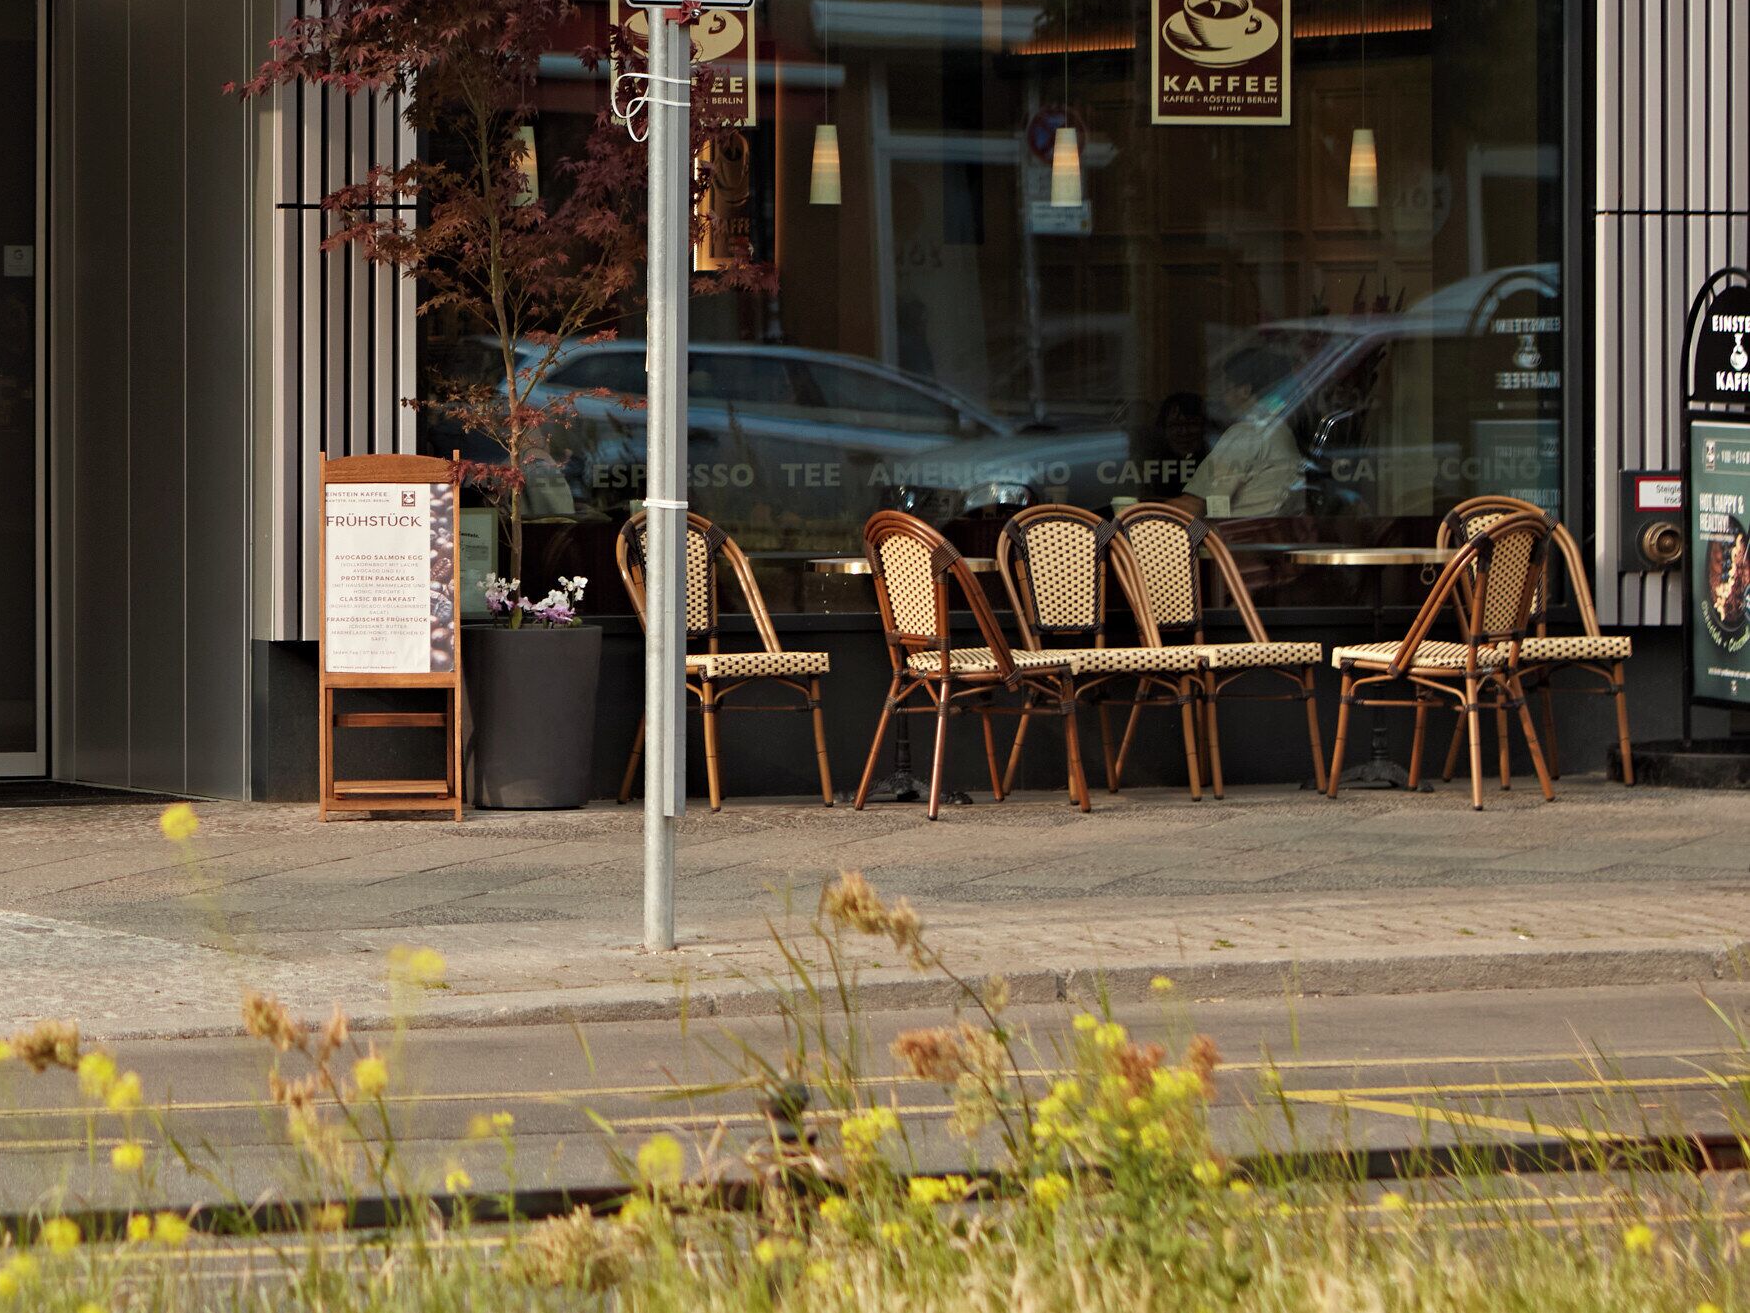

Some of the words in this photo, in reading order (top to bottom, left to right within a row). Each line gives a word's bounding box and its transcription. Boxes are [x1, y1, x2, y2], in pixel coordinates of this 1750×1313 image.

[1163, 75, 1278, 93] KAFFEE
[711, 96, 743, 105] BERLIN
[1163, 95, 1194, 104] KAFFEE
[1203, 93, 1245, 105] RÖSTEREI
[1247, 96, 1278, 105] BERLIN
[782, 463, 841, 487] TEE
[325, 512, 423, 528] FRÜHSTÜCK
